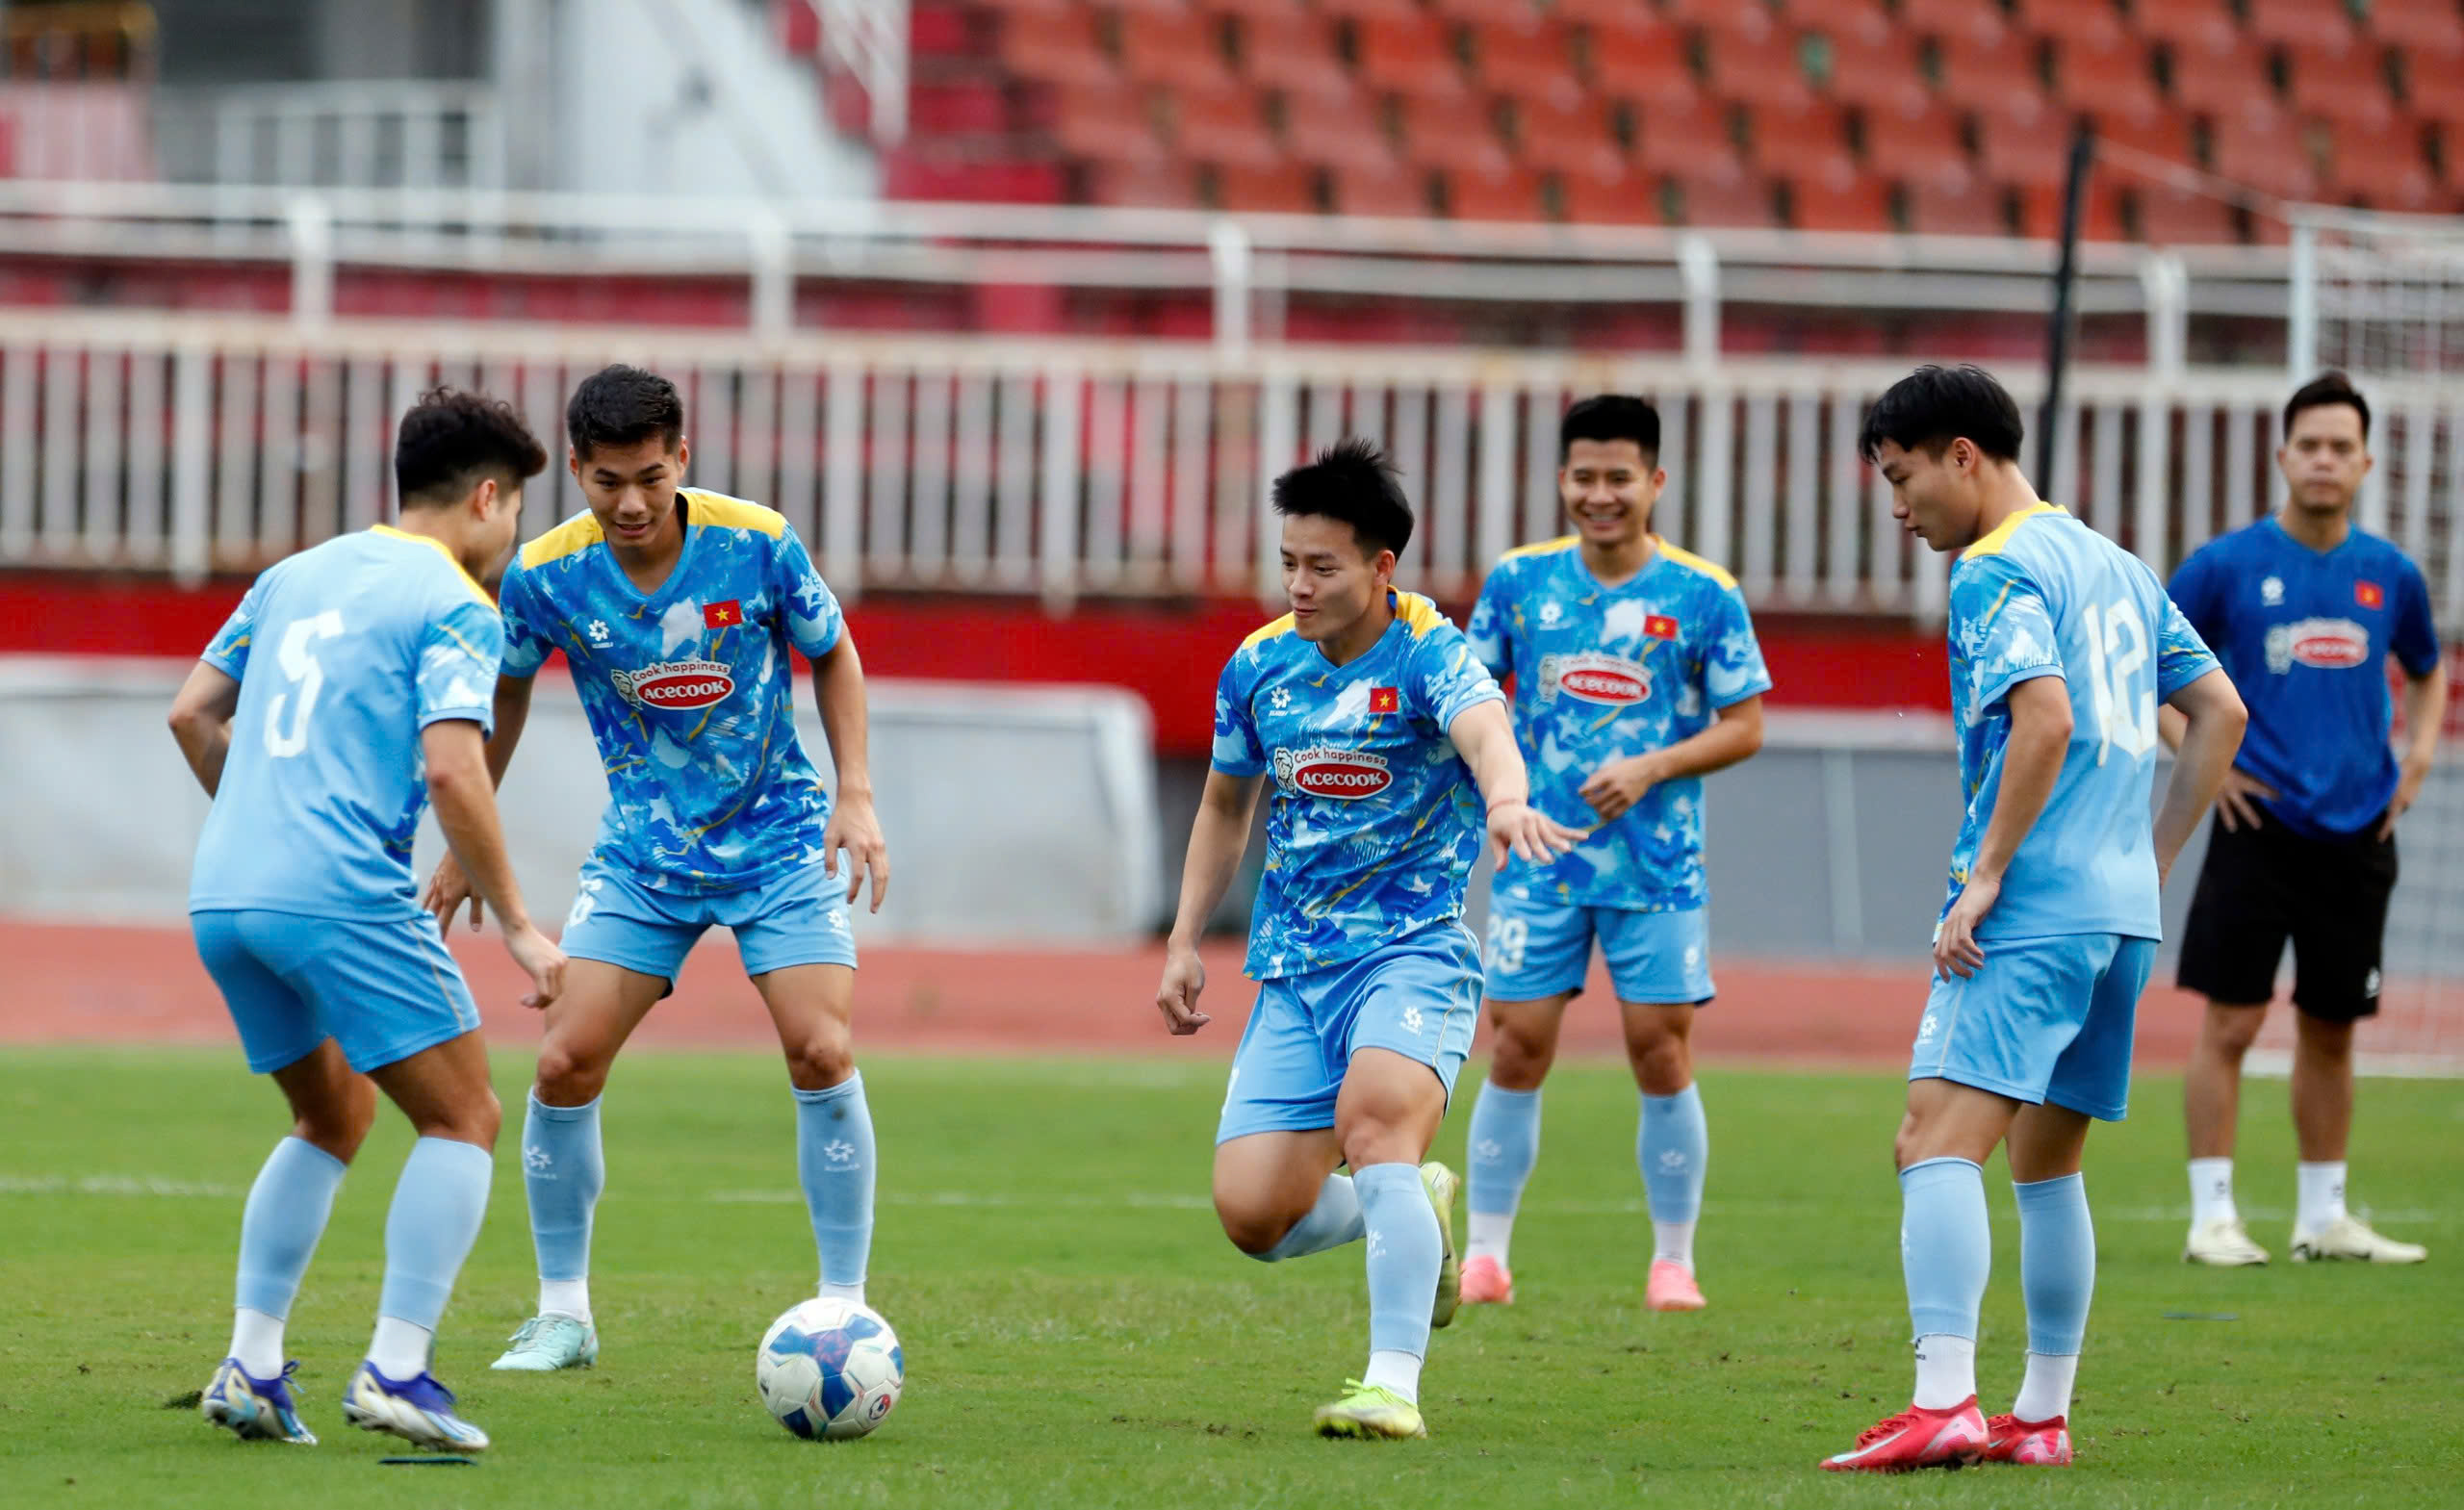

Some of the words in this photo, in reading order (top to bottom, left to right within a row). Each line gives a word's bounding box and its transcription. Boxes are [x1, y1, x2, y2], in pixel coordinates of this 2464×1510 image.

[263, 609, 343, 758] 5
[631, 665, 662, 681] Cook
[663, 662, 728, 673] happiness
[2084, 598, 2158, 768] 12
[1295, 748, 1320, 763] Cook
[1323, 748, 1387, 765] happiness
